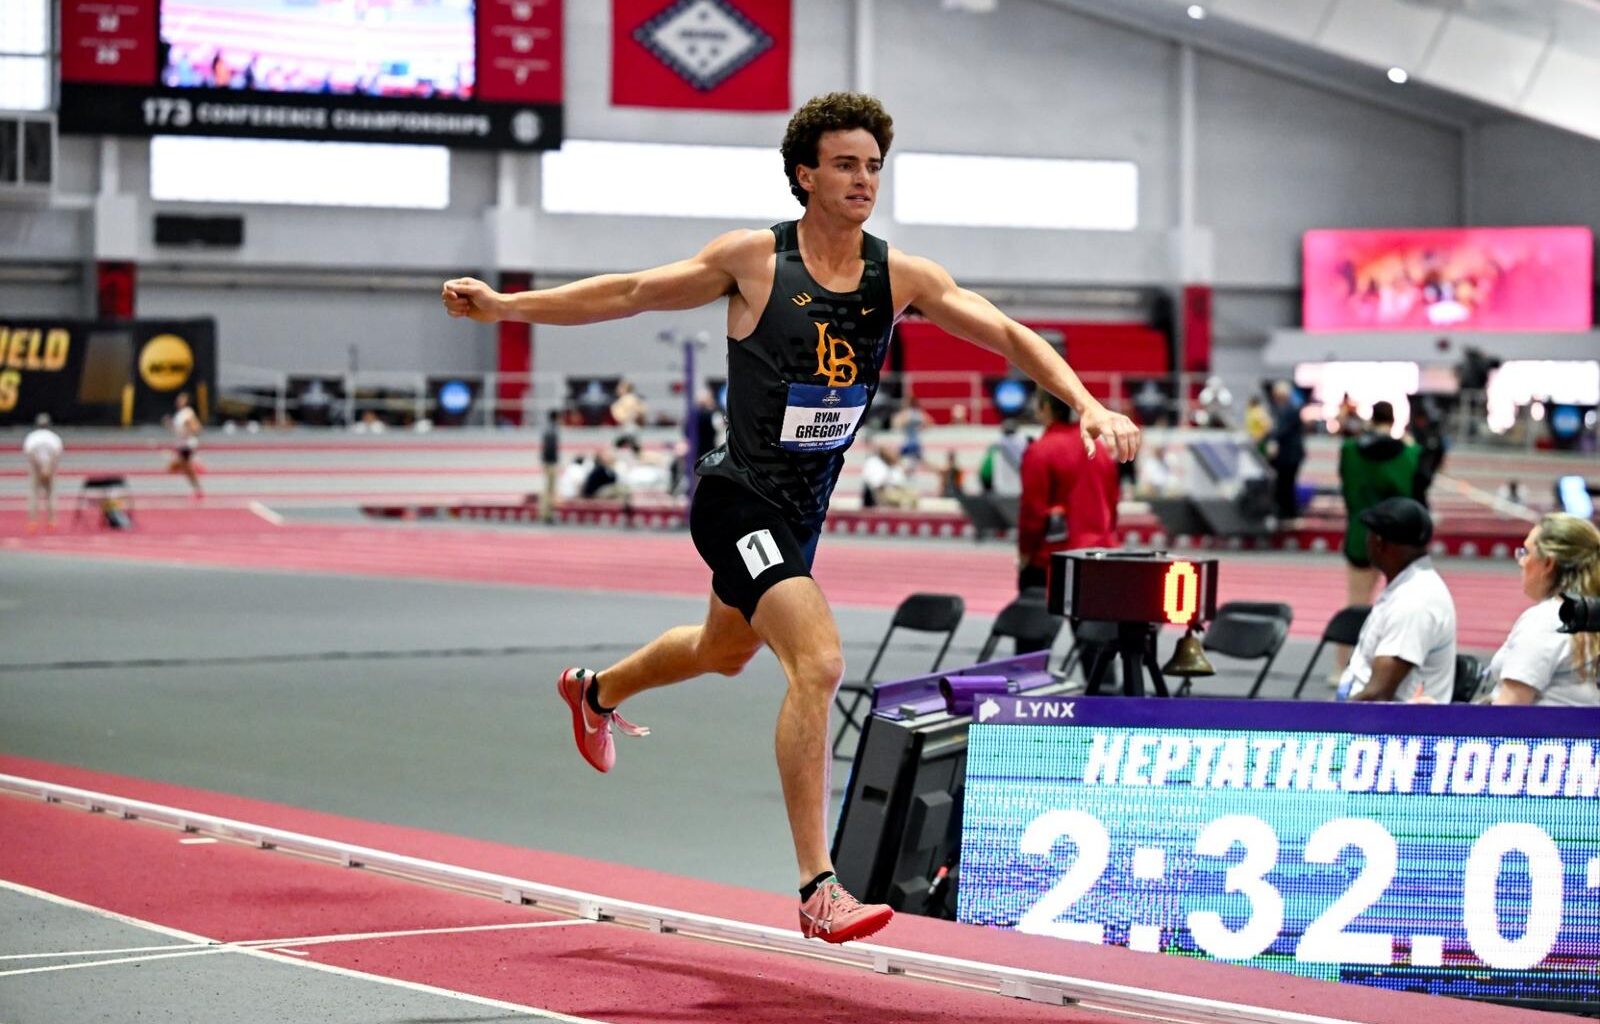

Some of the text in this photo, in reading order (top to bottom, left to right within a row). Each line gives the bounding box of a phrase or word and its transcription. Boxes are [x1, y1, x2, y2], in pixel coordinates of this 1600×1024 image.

[143, 98, 490, 136] 173 CONFERENCE CHAMPIONSHIPS
[813, 321, 858, 387] LB
[795, 423, 851, 439] GREGORY
[814, 412, 840, 423] RYAN
[746, 533, 771, 567] 1
[1163, 560, 1198, 625] 0
[1015, 701, 1075, 719] LYNX
[1083, 733, 1423, 794] HEPTATHLON
[1016, 808, 1600, 970] 2:32.0
